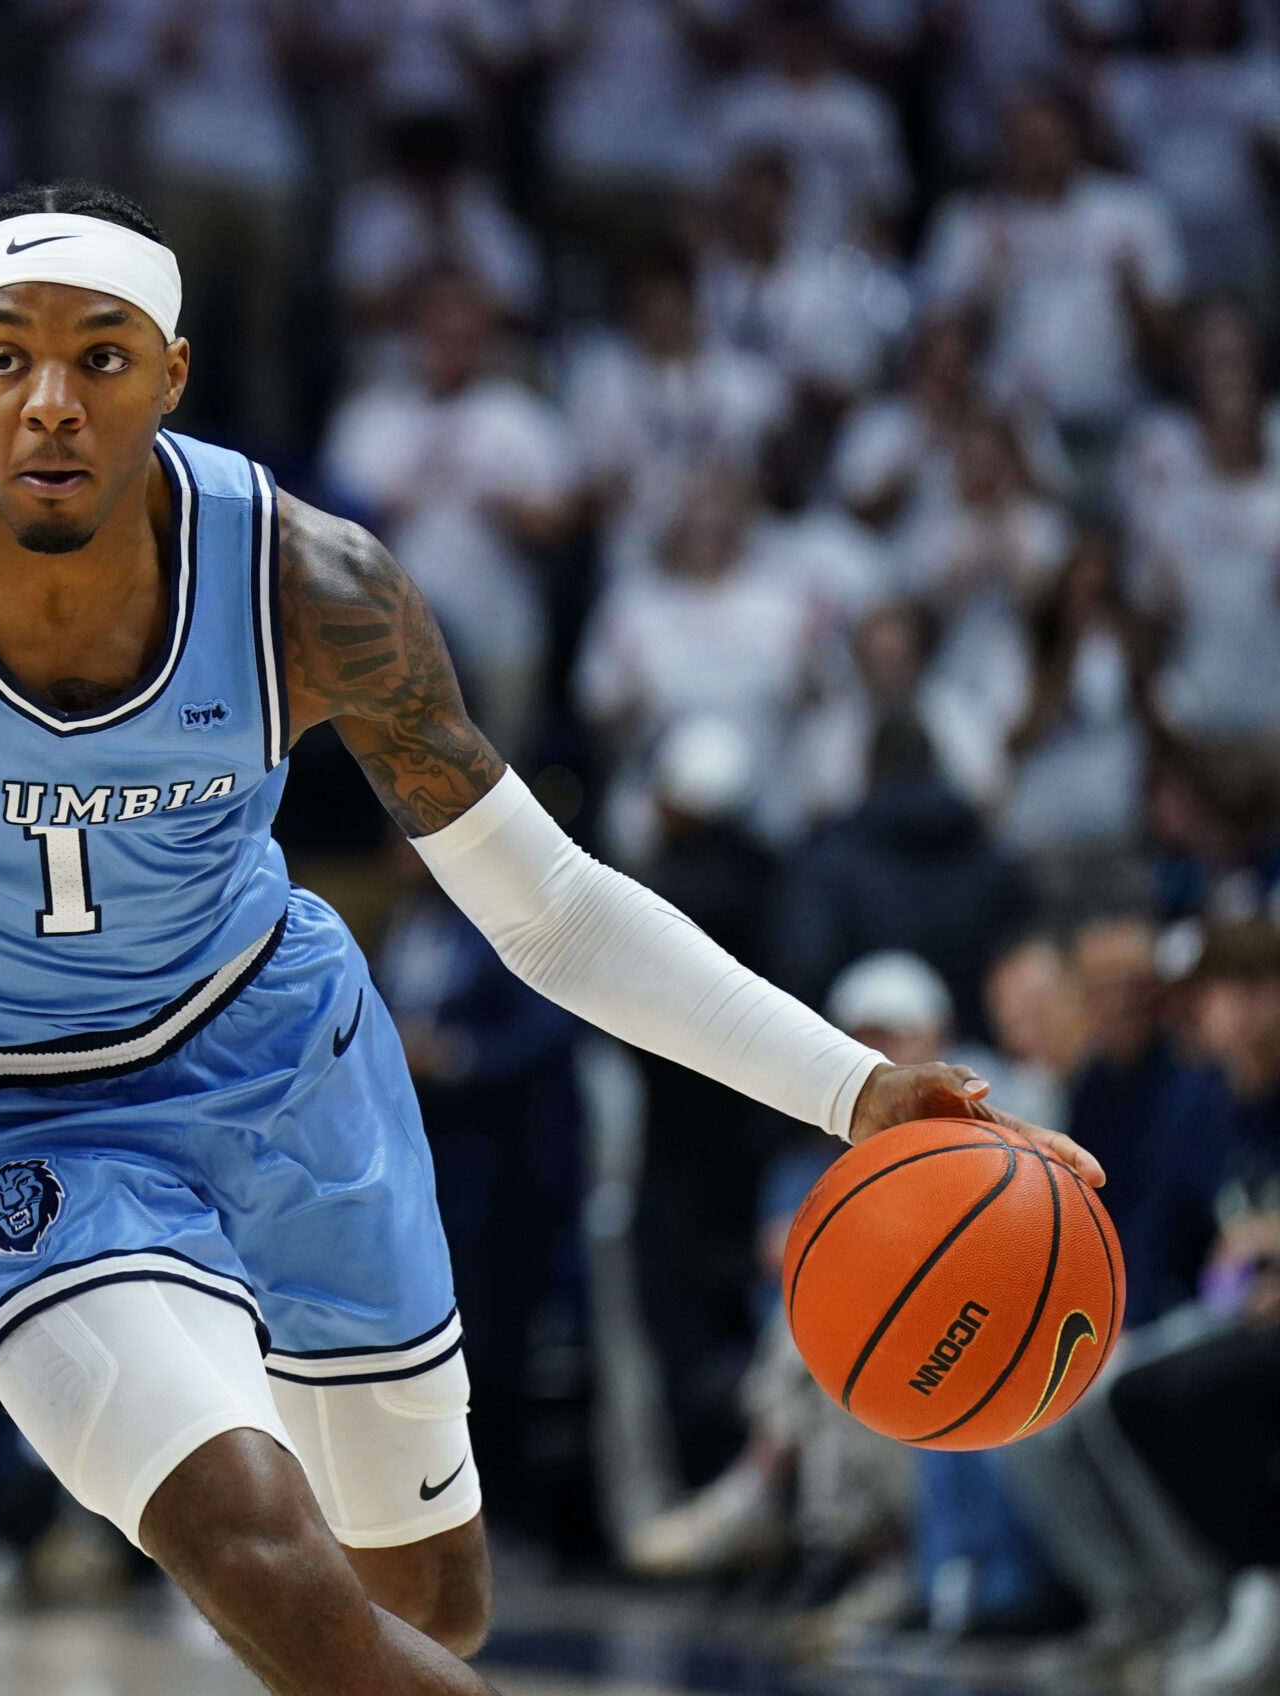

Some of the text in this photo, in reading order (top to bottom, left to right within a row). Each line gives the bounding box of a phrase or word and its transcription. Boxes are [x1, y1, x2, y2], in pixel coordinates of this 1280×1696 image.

[184, 709, 210, 725] Ivy
[23, 826, 102, 938] 1
[908, 1300, 990, 1396] UCONN
